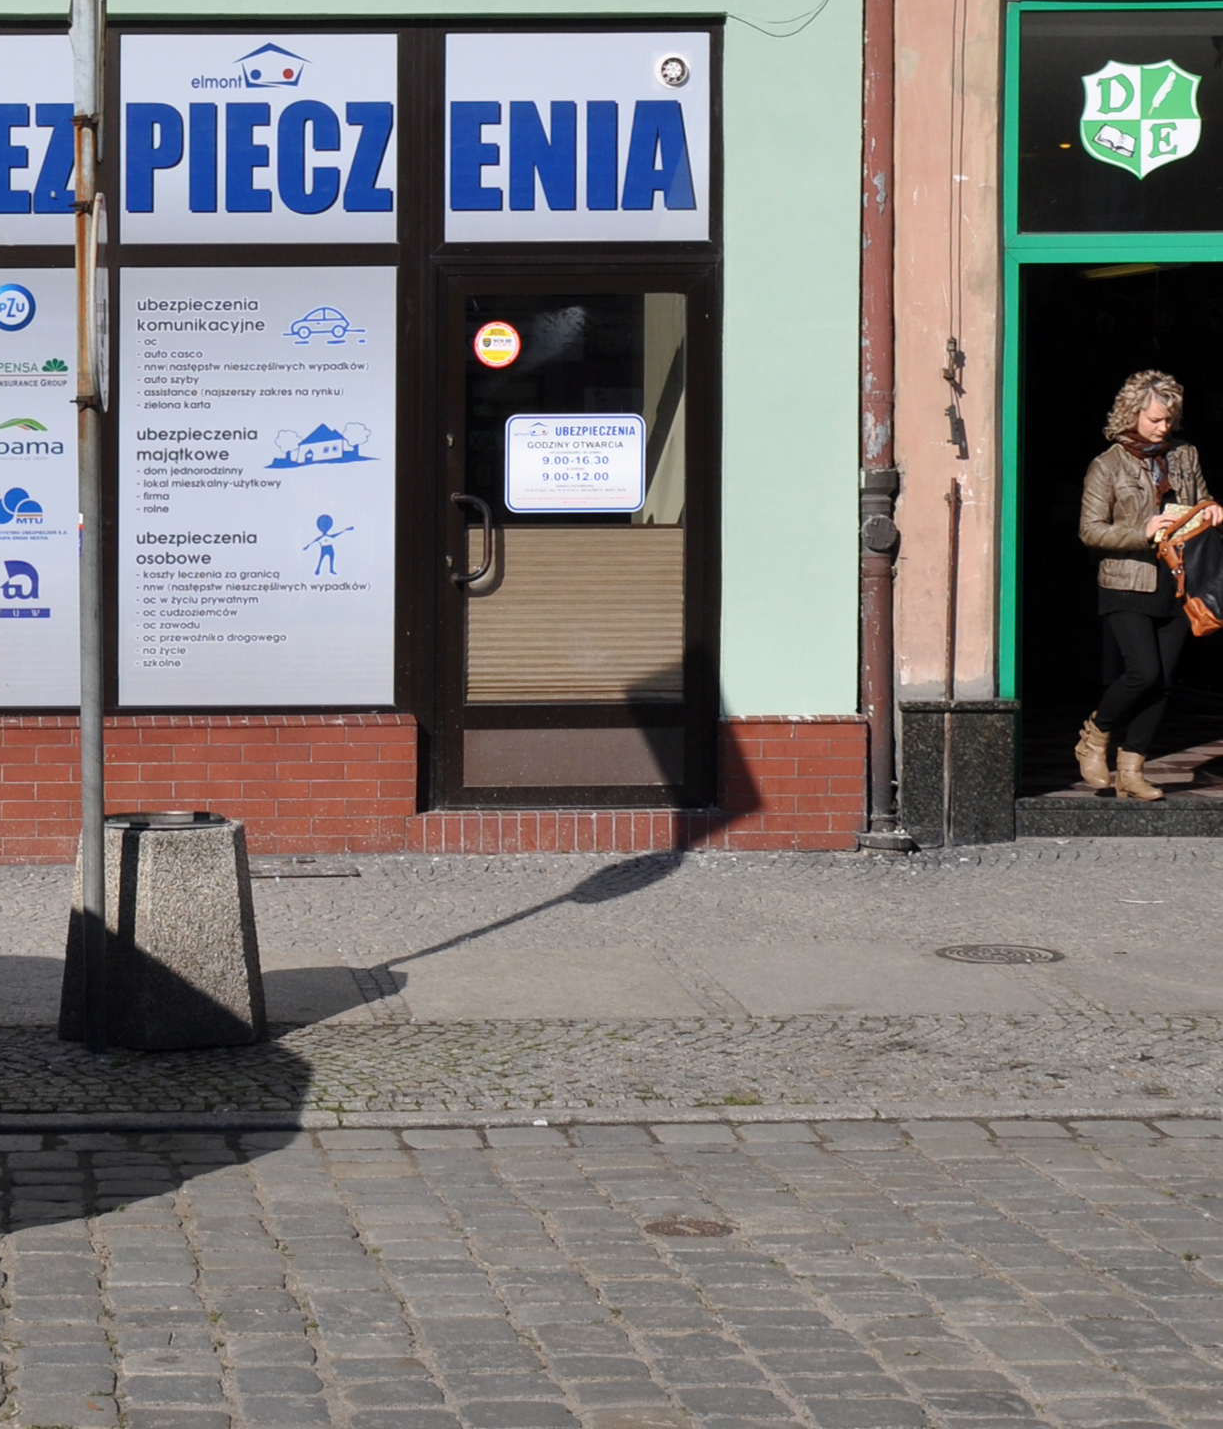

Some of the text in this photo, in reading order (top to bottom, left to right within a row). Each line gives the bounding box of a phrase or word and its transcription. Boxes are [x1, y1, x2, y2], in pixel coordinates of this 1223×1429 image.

[191, 74, 242, 89] elmont
[1097, 73, 1135, 115] D
[1148, 122, 1178, 159] E
[137, 299, 258, 314] ubezpieczenia
[137, 319, 265, 334] komunikacyjne
[144, 350, 167, 358] auto
[224, 362, 305, 373] nieszczęśliwych
[309, 362, 369, 373] wypadków)
[171, 376, 199, 386] szyby
[144, 388, 198, 396] assistance
[201, 388, 256, 398] (najszerszy
[259, 388, 292, 396] zakres
[312, 388, 344, 398] rynku)
[144, 401, 211, 409] zielona karta
[137, 428, 258, 443] ubezpieczenia
[556, 426, 635, 436] UBEZPIECZENIA
[137, 448, 229, 464] majątkowe
[542, 456, 609, 465] 9.00-16.30
[144, 467, 243, 477] dom jednorodzinny
[542, 473, 609, 481] 9.00-12.00
[144, 479, 281, 489] lokal mieszkalny-użytkowy
[144, 505, 169, 513] rolne
[137, 532, 257, 547] ubezpieczenia
[136, 552, 211, 565] osobowe
[143, 571, 175, 581] koszty
[240, 571, 280, 581] granicą
[167, 583, 222, 593] (następstw
[226, 582, 307, 593] nieszczęśliwych
[311, 582, 371, 593] wypadków)
[171, 595, 198, 606] życiu
[201, 596, 258, 606] prywatnym
[160, 608, 237, 616] cudzoziemców
[160, 621, 200, 629] zawodu
[160, 633, 224, 643] przewoźnika
[227, 633, 286, 643] drogowego
[160, 646, 186, 656] życie
[143, 659, 180, 667] szkolne
